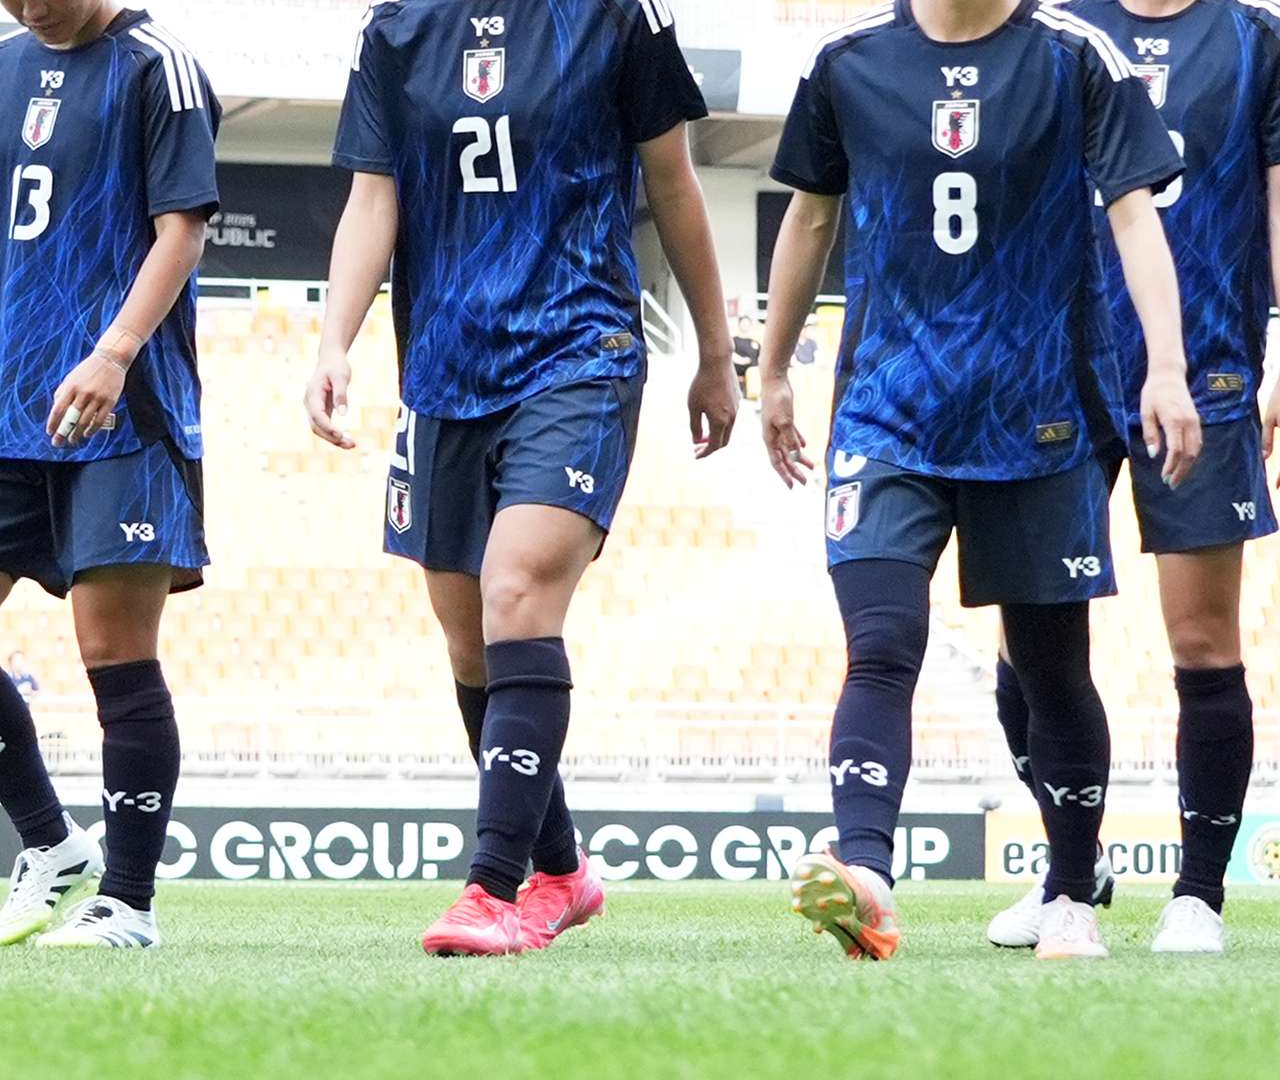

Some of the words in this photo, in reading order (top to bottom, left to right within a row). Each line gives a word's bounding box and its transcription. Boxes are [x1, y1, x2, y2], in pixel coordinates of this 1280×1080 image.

[470, 16, 504, 37] Y-3
[1134, 37, 1169, 56] Y-3
[40, 70, 65, 88] Y-3
[941, 66, 978, 87] Y-3
[452, 115, 517, 192] 21
[8, 164, 53, 241] 13
[933, 172, 978, 254] 8
[565, 467, 595, 494] Y-3
[1232, 502, 1256, 521] Y-3
[120, 523, 155, 542] Y-3
[1062, 556, 1101, 578] Y-3
[482, 747, 540, 776] Y-3
[830, 759, 888, 786] Y-3
[103, 788, 162, 813] Y-3
[1044, 782, 1103, 807] Y-3
[210, 821, 464, 880] GROUP
[575, 824, 698, 880] CO
[710, 825, 950, 880] GRP
[1003, 842, 1184, 875] eacom
